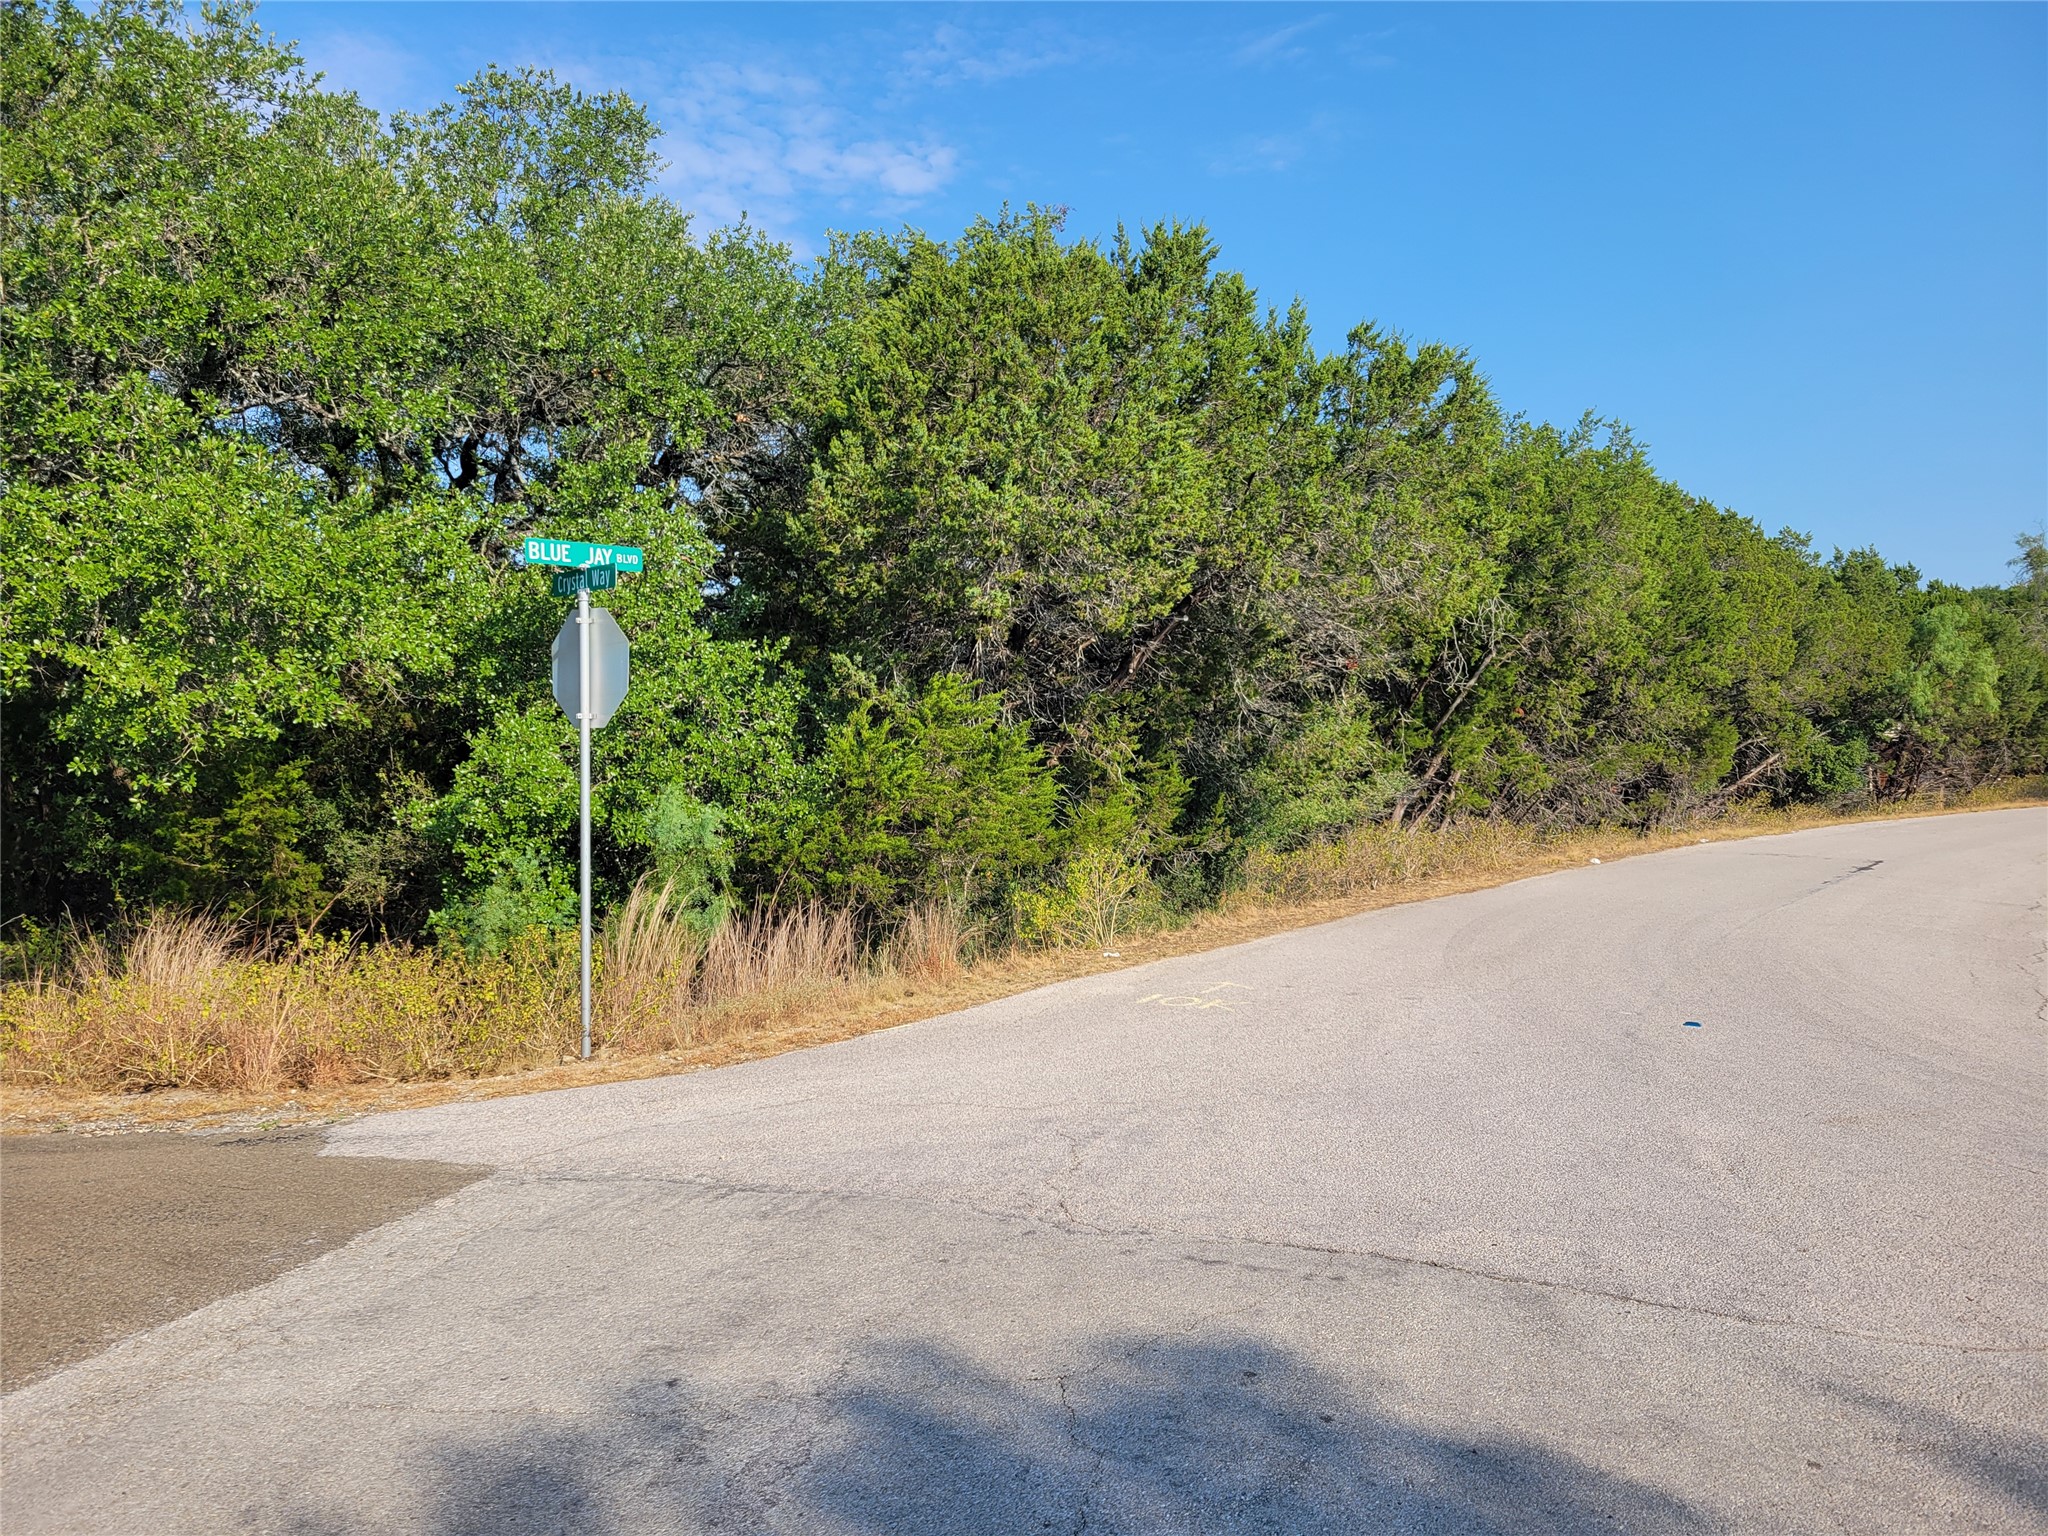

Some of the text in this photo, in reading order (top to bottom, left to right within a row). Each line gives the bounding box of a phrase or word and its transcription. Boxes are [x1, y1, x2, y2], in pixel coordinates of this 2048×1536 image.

[528, 541, 639, 565] BLUE JAY BLVD
[557, 569, 611, 595] Crystal Way
